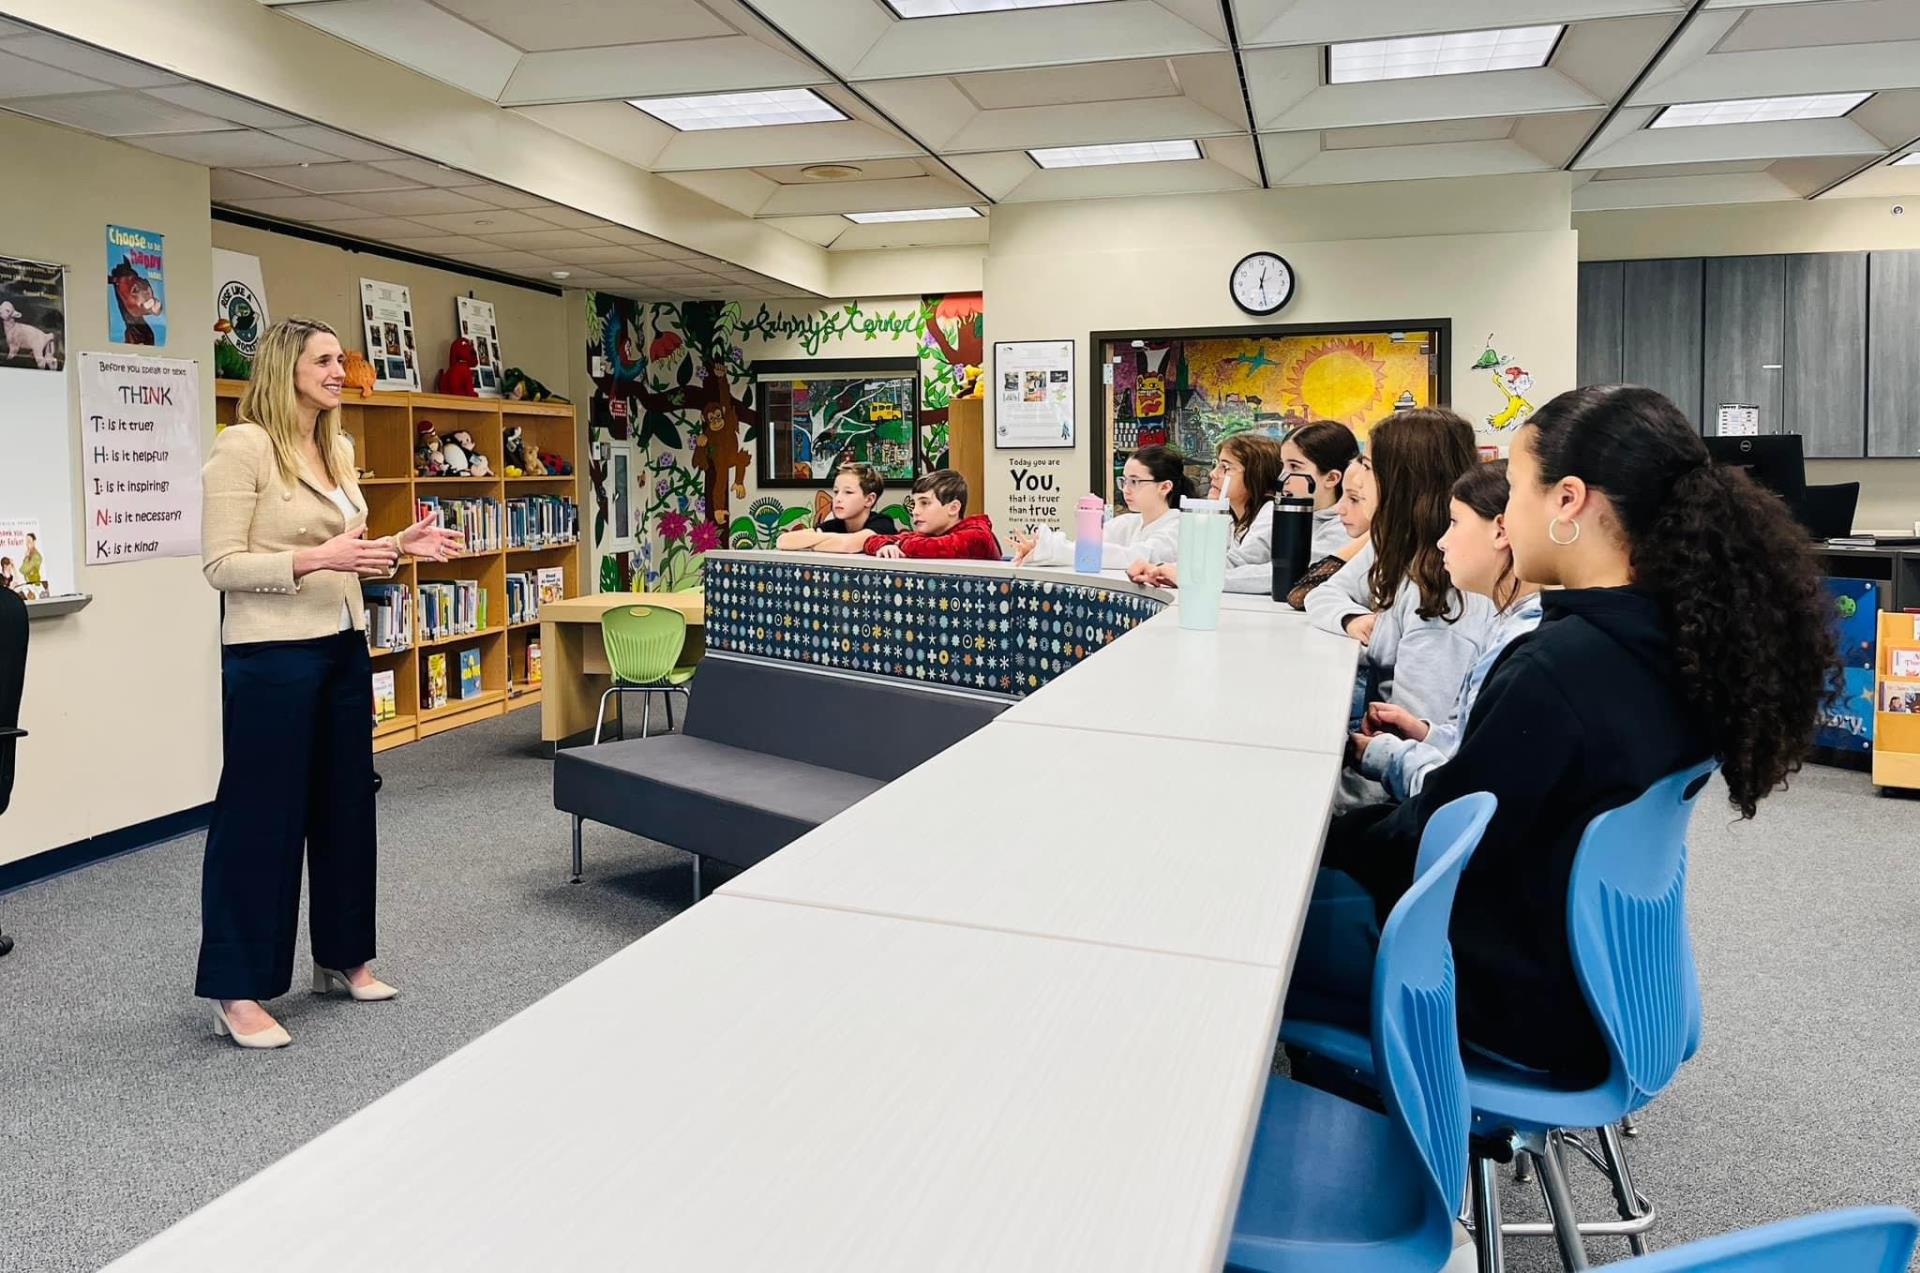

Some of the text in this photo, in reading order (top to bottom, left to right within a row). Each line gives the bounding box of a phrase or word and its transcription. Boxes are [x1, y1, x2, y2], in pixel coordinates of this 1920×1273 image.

[109, 228, 146, 249] Choose
[221, 286, 252, 309] RISE LIKE A
[848, 306, 920, 333] Corner
[99, 361, 126, 373] Before
[127, 365, 140, 374] you
[118, 385, 173, 406] THINK
[90, 415, 154, 433] T: is it true?
[94, 446, 169, 464] H: is it helpful?
[1009, 458, 1032, 468] Today
[1033, 459, 1046, 468] you
[106, 481, 114, 493] is
[117, 481, 125, 492] it
[127, 480, 169, 493] inspiring?
[1010, 468, 1060, 492] You,
[1009, 494, 1060, 502] that is truer
[96, 508, 182, 526] N: is it necessary?
[1009, 503, 1057, 516] than true
[96, 540, 111, 559] K:
[114, 542, 121, 554] is
[124, 542, 132, 553] it
